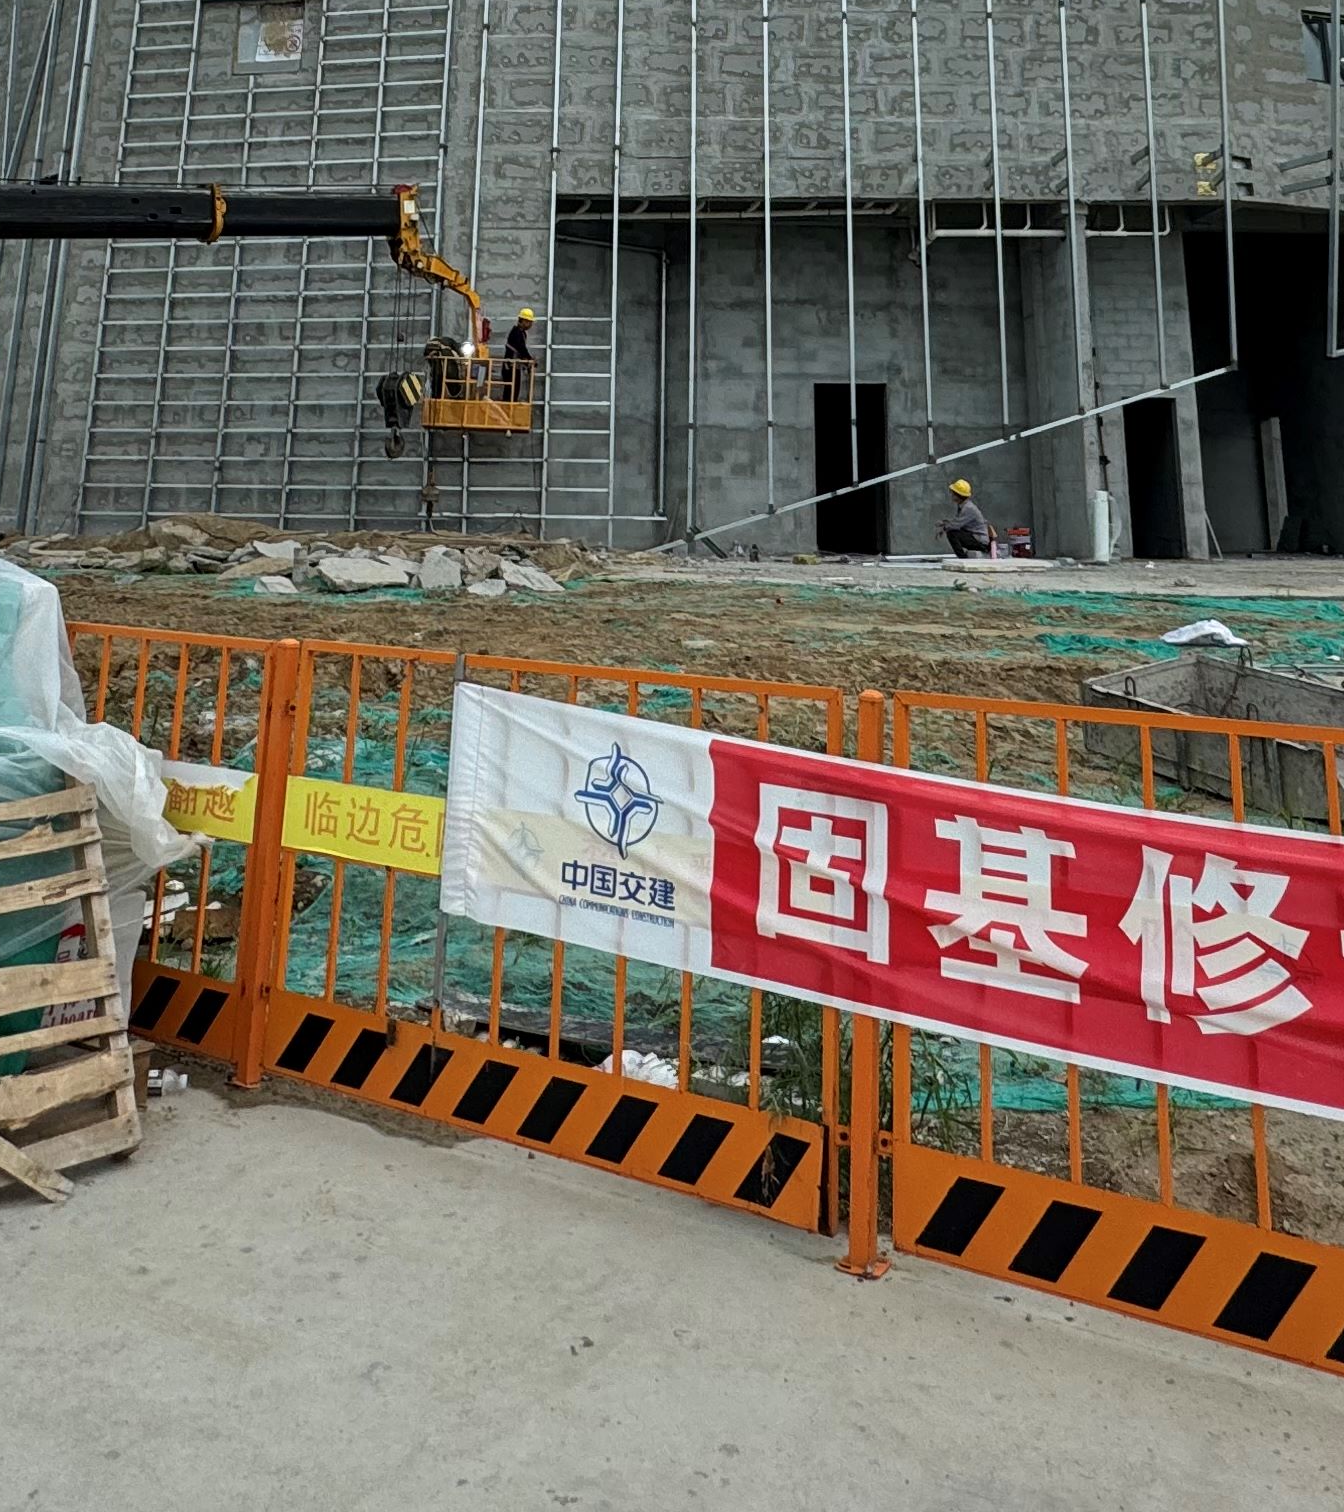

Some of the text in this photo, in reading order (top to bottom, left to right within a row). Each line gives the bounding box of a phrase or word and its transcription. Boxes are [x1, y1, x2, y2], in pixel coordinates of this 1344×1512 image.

[167, 777, 236, 823] 翻越
[304, 791, 445, 858] 临边危
[559, 894, 576, 906] CHINA
[561, 859, 675, 911] 中国交建
